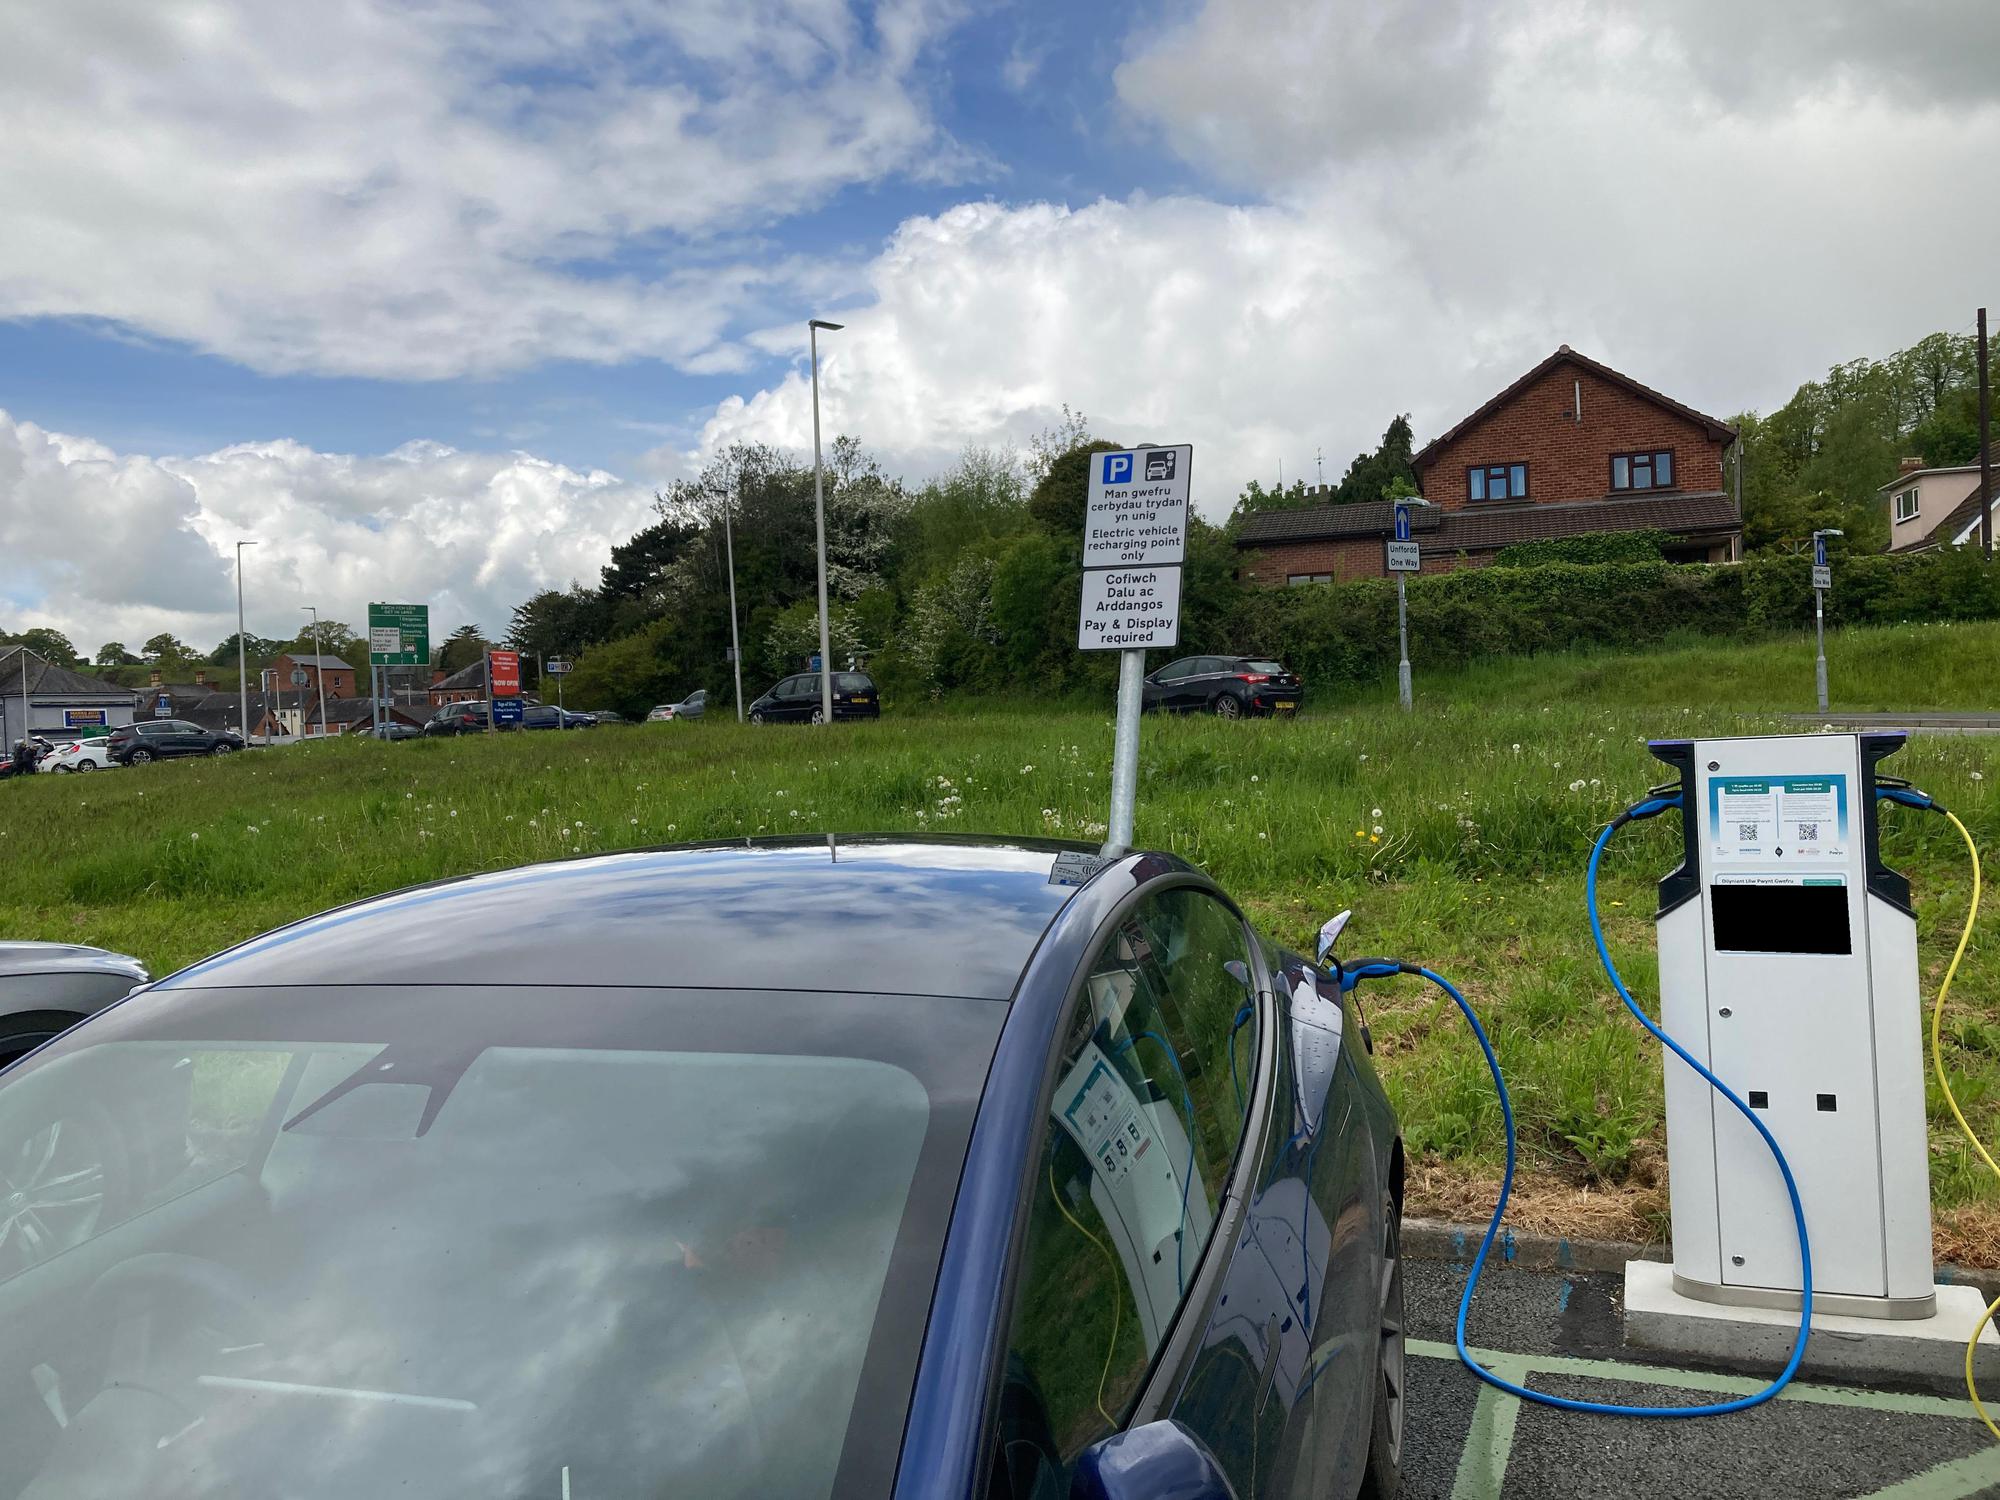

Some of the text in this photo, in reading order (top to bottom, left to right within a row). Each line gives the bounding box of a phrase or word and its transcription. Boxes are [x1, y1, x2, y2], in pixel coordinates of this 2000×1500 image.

[1110, 457, 1128, 482] P
[1104, 486, 1171, 499] Man gwefru
[1091, 498, 1183, 512] cerbydau trydan
[1115, 511, 1156, 523] yn unig
[1092, 525, 1178, 539] Electric vehicle
[1088, 536, 1181, 550] recharging point
[1390, 545, 1417, 553] Unffordd
[1120, 550, 1145, 561] only
[1391, 558, 1418, 568] One Way
[1105, 572, 1157, 585] Cofiwch
[1107, 587, 1154, 598] Dalu ac
[1095, 600, 1163, 612] Arddangos
[1084, 617, 1173, 632] Pay & Display
[1100, 631, 1154, 644] required
